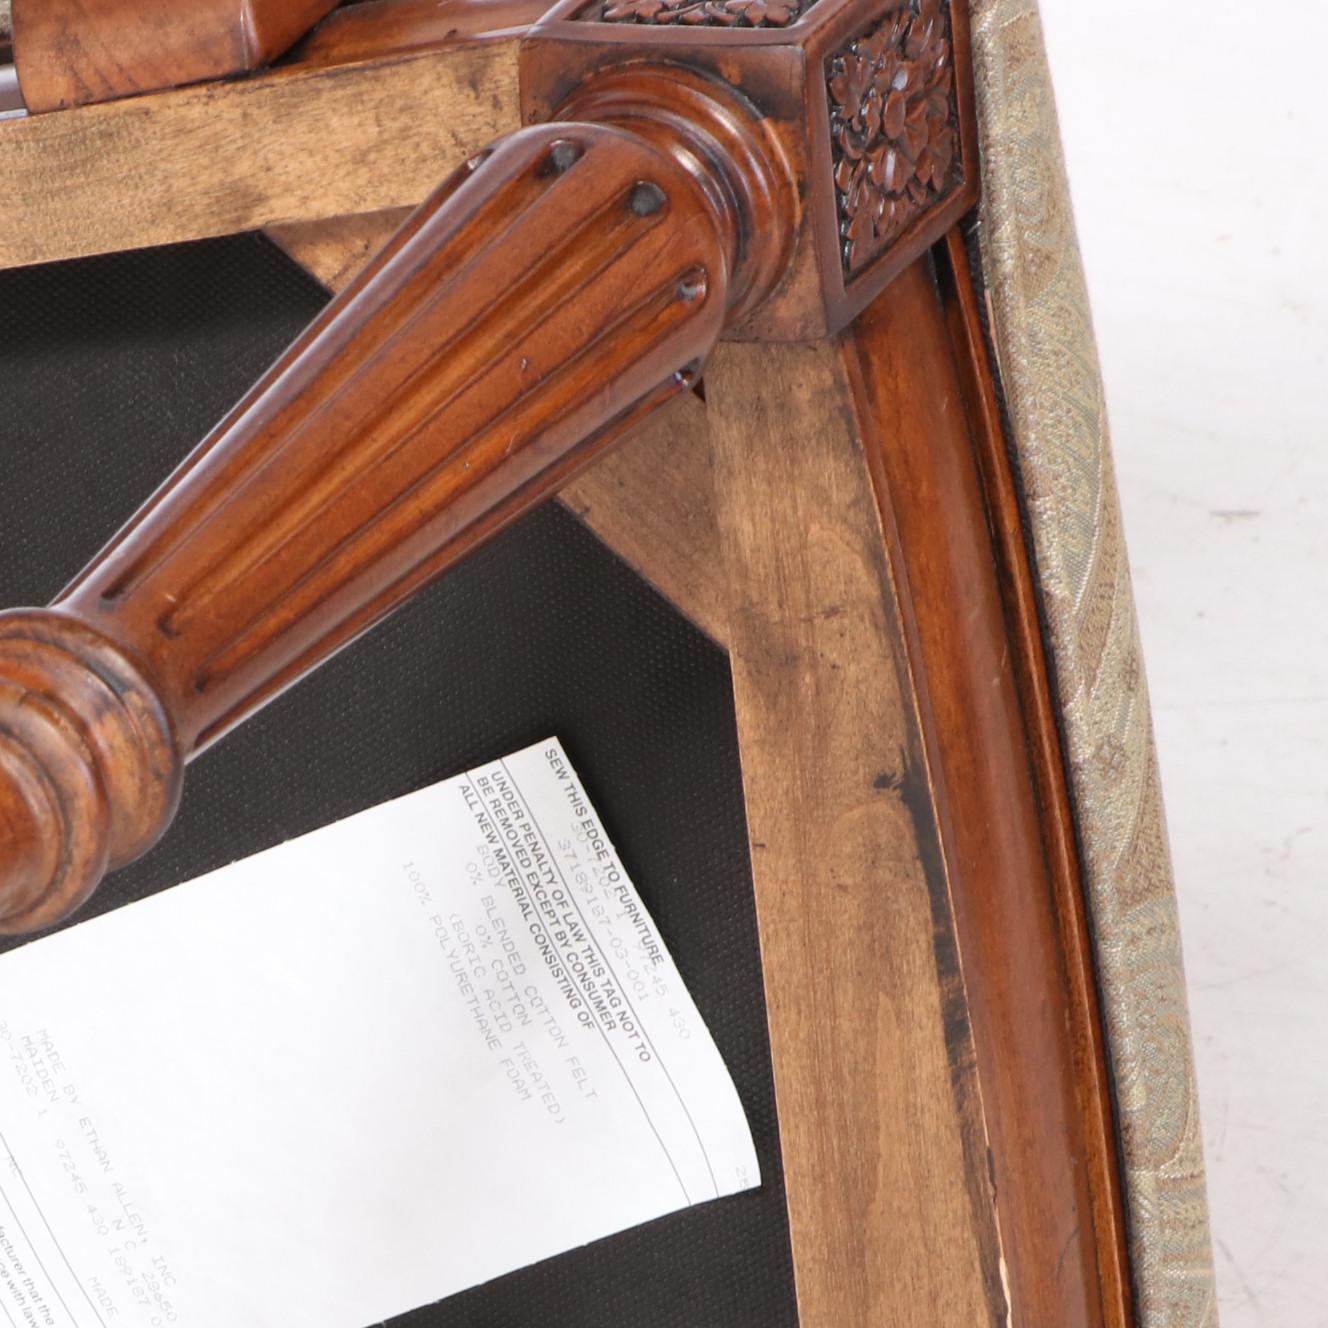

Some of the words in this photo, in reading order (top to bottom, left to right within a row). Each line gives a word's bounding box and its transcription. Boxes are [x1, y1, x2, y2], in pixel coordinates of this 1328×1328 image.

[460, 785, 478, 811] ALL
[474, 812, 499, 844] NEW
[493, 847, 533, 921] MATERIAL
[529, 923, 582, 1010] CONSISTING
[577, 1011, 595, 1029] OF
[477, 777, 495, 797] BE
[489, 798, 532, 869] REMOVED
[526, 871, 561, 926] EXCEPT
[554, 930, 572, 948] BY
[566, 952, 617, 1031] CONSUMER
[491, 771, 525, 821] UNDER
[519, 822, 558, 885] PENALTY
[551, 889, 570, 909] OF
[562, 912, 587, 943] LAW
[581, 944, 606, 978] THIS
[600, 978, 622, 1009] TAG
[616, 1010, 640, 1038] NOT
[635, 1042, 651, 1062] TO
[545, 749, 569, 780] SEW
[564, 783, 588, 818] THIS
[580, 819, 609, 862] EDGE
[603, 862, 620, 883] TO
[613, 885, 664, 967] FURNITURE
[5, 1278, 26, 1307] with
[21, 1277, 44, 1304] that
[37, 1304, 55, 1326] the
